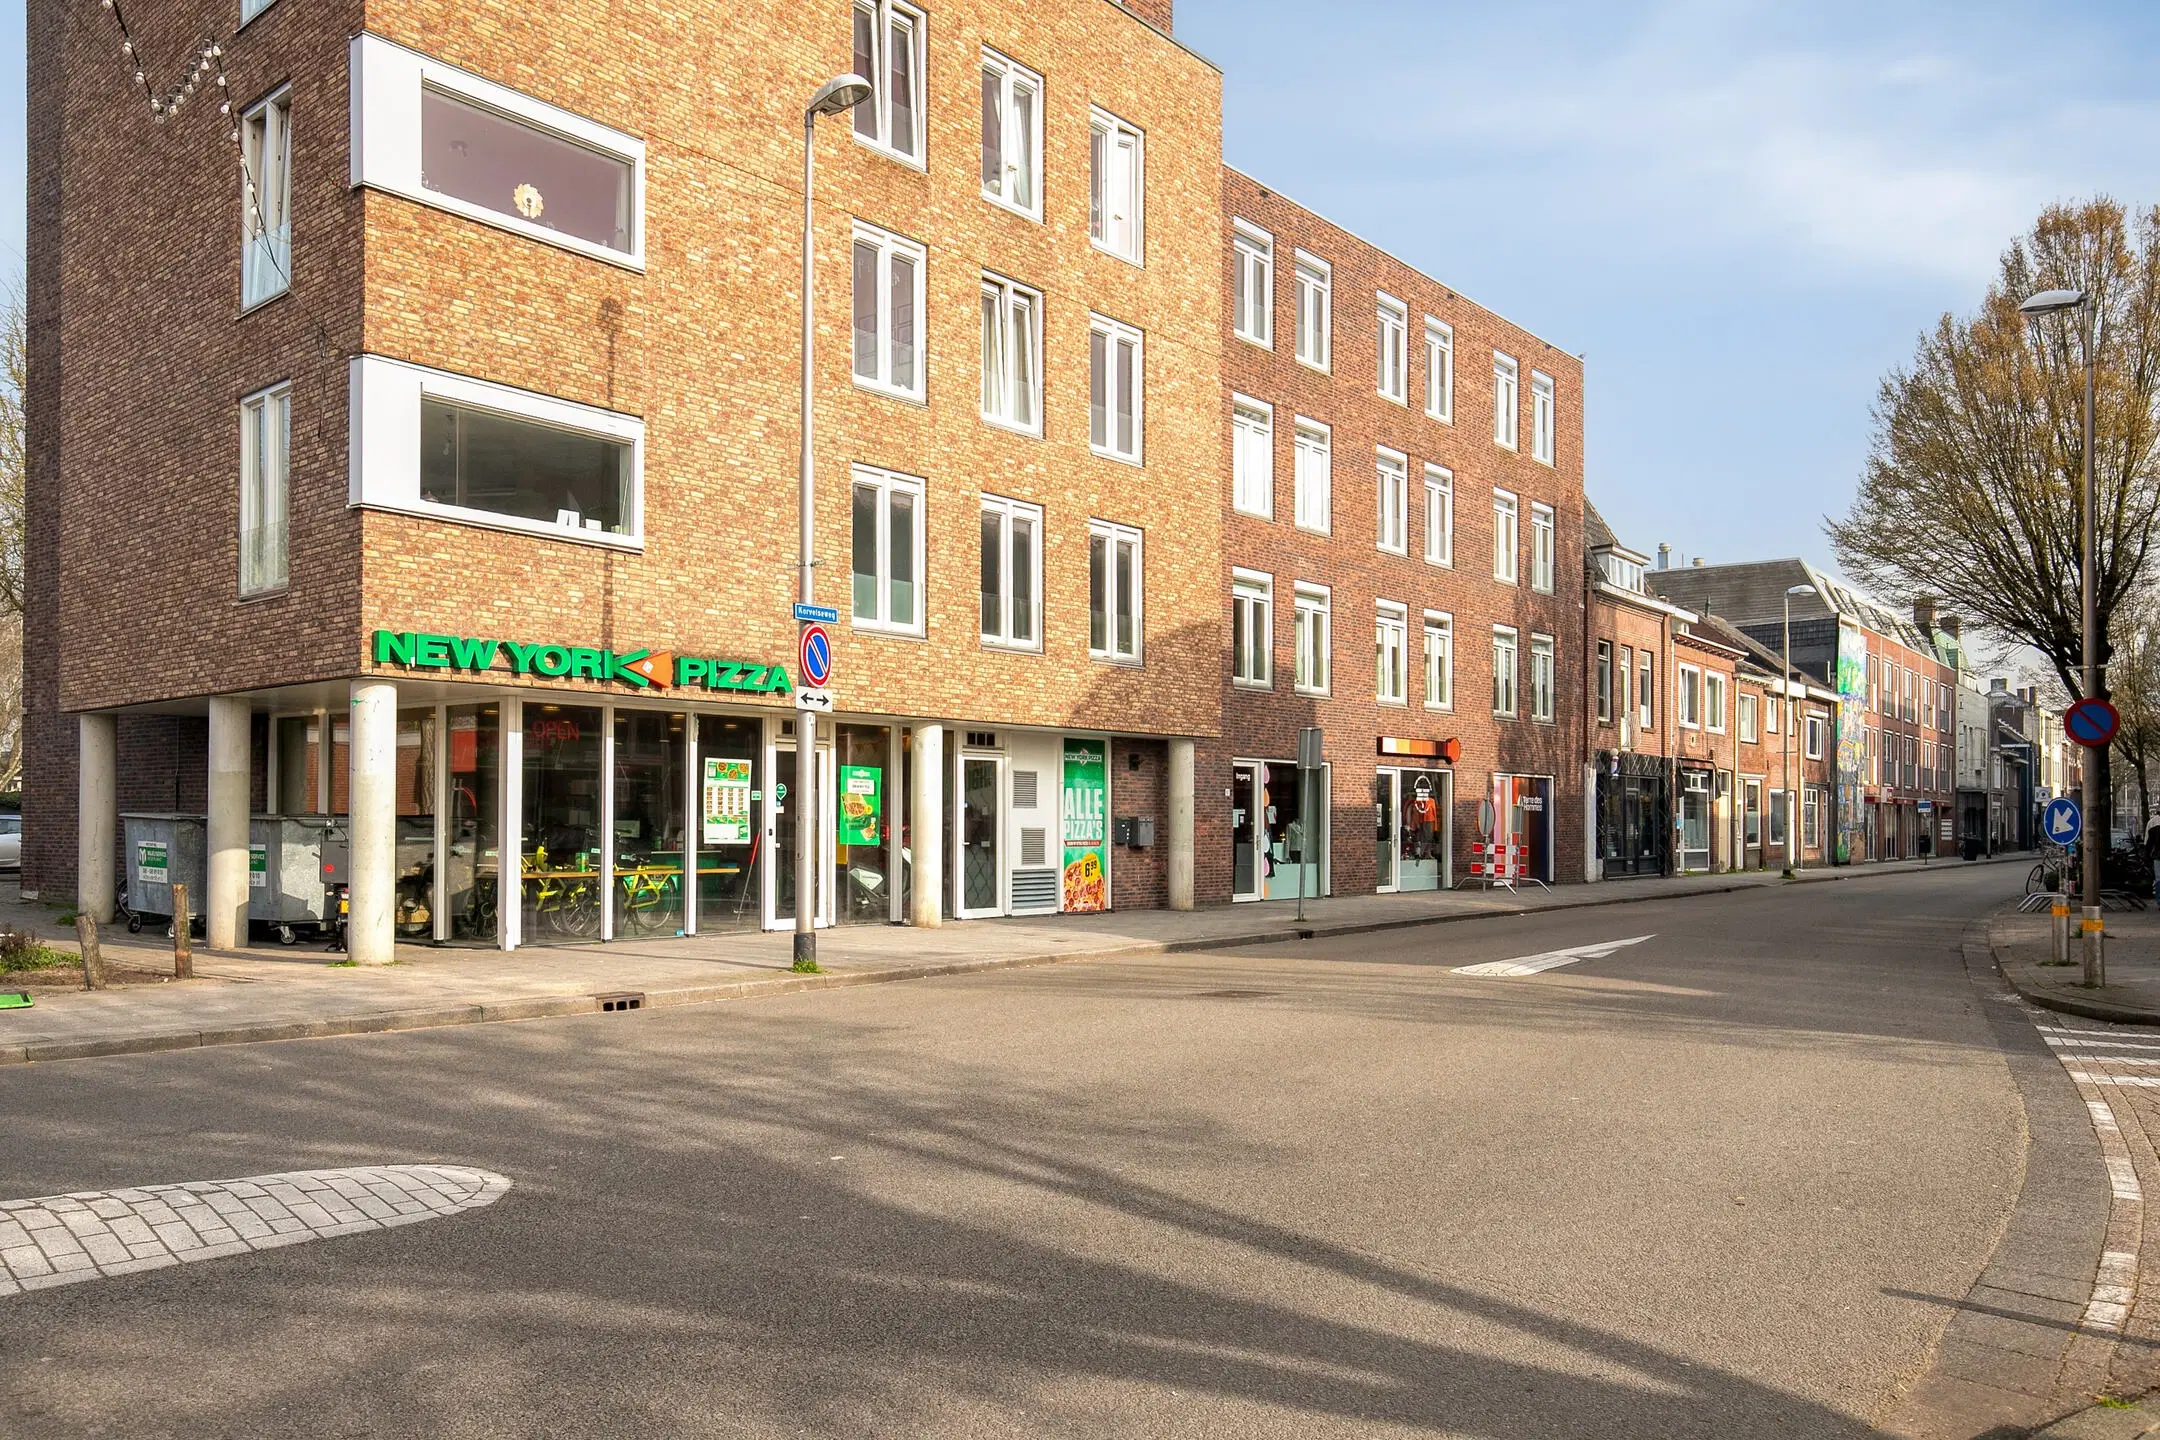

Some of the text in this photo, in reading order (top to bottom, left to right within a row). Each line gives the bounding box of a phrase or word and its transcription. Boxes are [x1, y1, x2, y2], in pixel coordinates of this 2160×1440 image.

[798, 606, 836, 620] Korvelseweg
[373, 630, 793, 692] NEW YORK PIZZA
[532, 720, 580, 741] OPEN
[1064, 788, 1102, 820] ALLE
[1064, 820, 1102, 840] PIZZA'S
